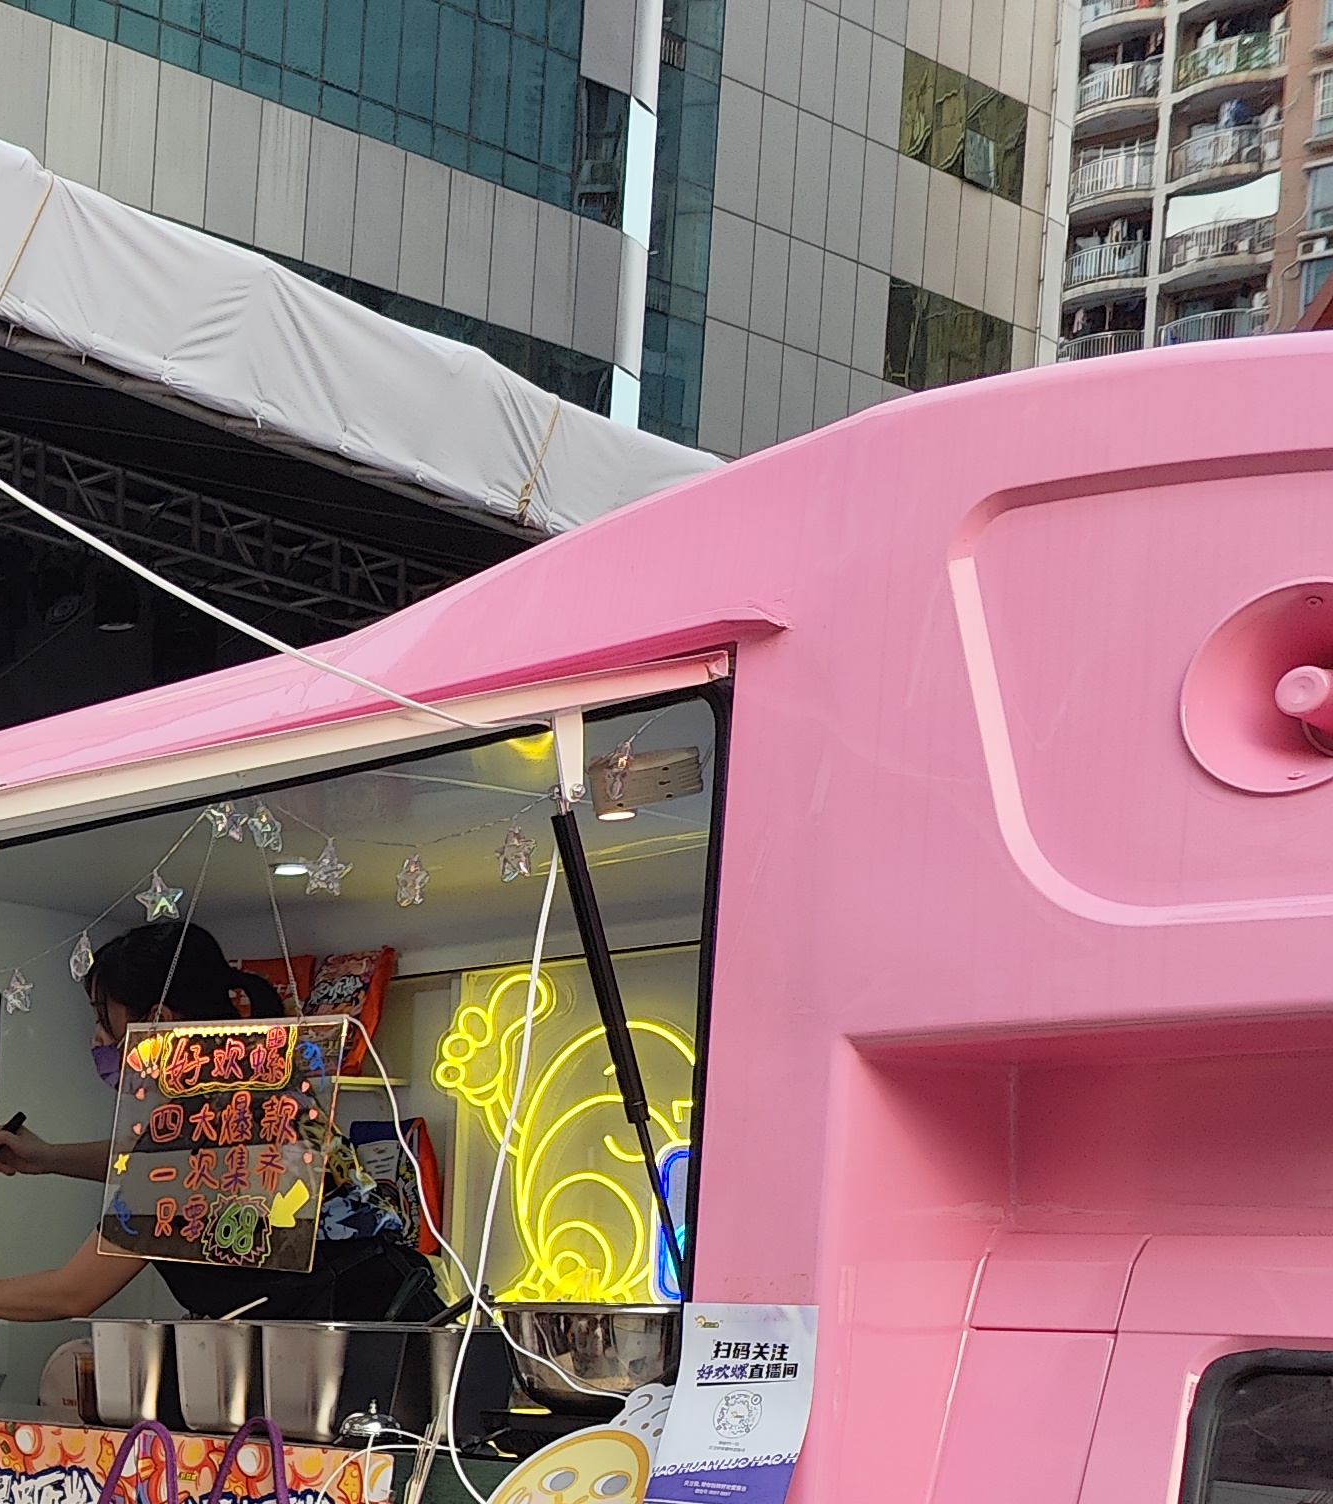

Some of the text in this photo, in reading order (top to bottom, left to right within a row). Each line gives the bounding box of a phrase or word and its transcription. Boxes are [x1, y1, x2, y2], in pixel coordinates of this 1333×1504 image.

[165, 1026, 286, 1091] 好欢螺
[150, 1091, 298, 1145] 四大爆款
[149, 1145, 287, 1193] 一次集齐
[215, 1202, 258, 1255] 68
[696, 1363, 799, 1380] 好欢螺直播间
[713, 1341, 789, 1361] 扫码关注
